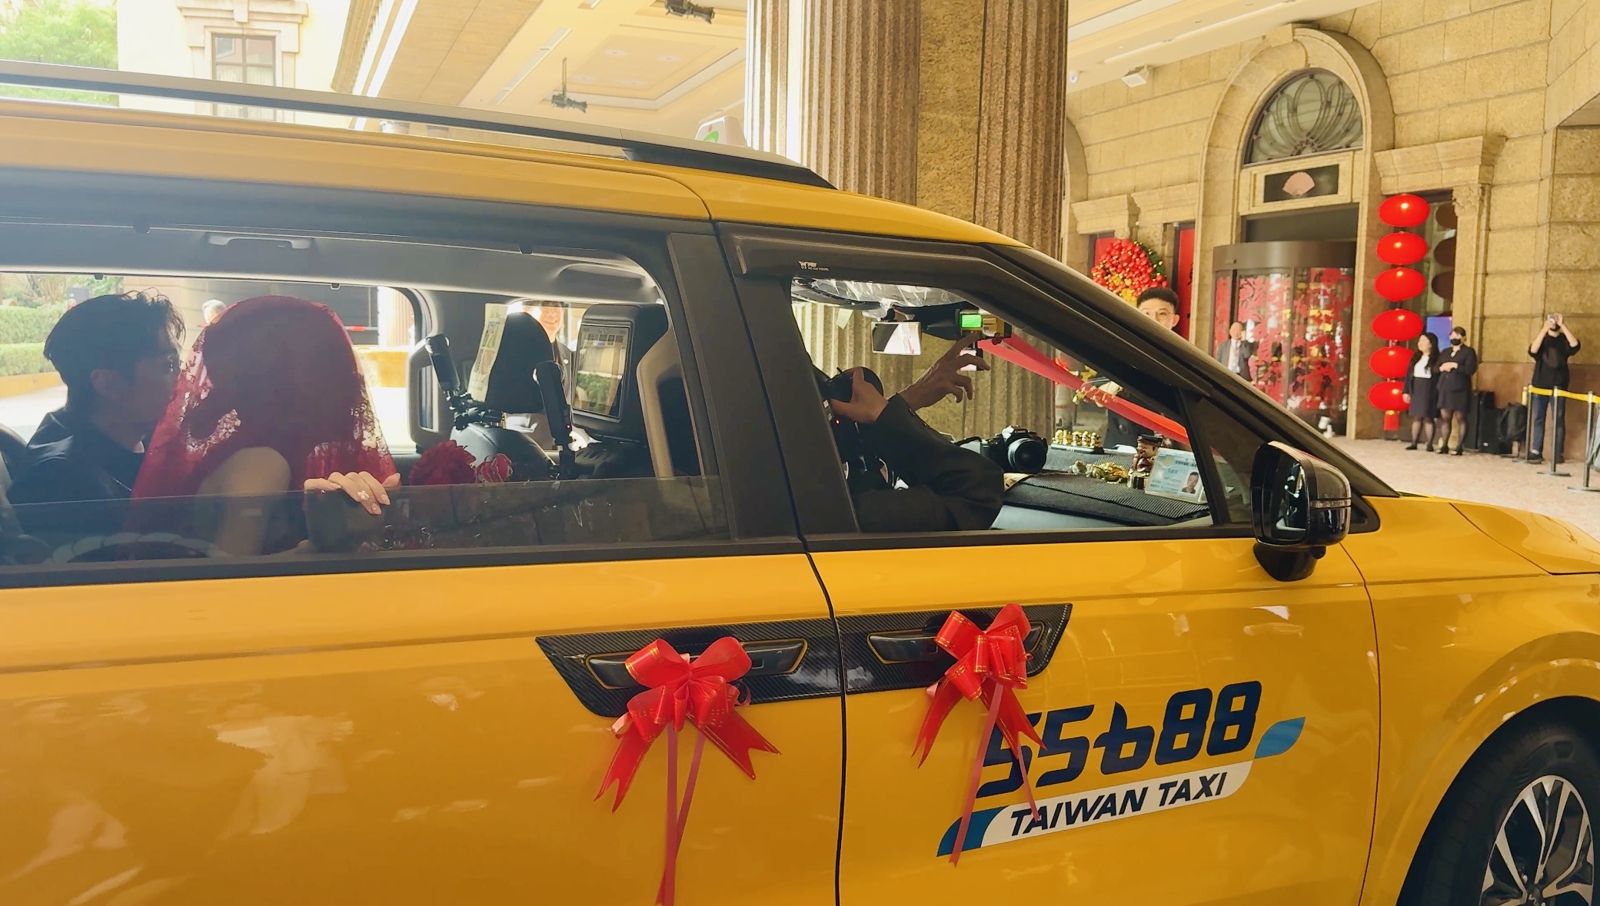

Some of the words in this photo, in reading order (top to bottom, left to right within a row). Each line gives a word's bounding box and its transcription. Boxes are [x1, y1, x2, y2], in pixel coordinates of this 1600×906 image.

[976, 681, 1261, 799] 55688
[1010, 786, 1149, 836] TAIWAN
[1158, 772, 1228, 807] TAXI
